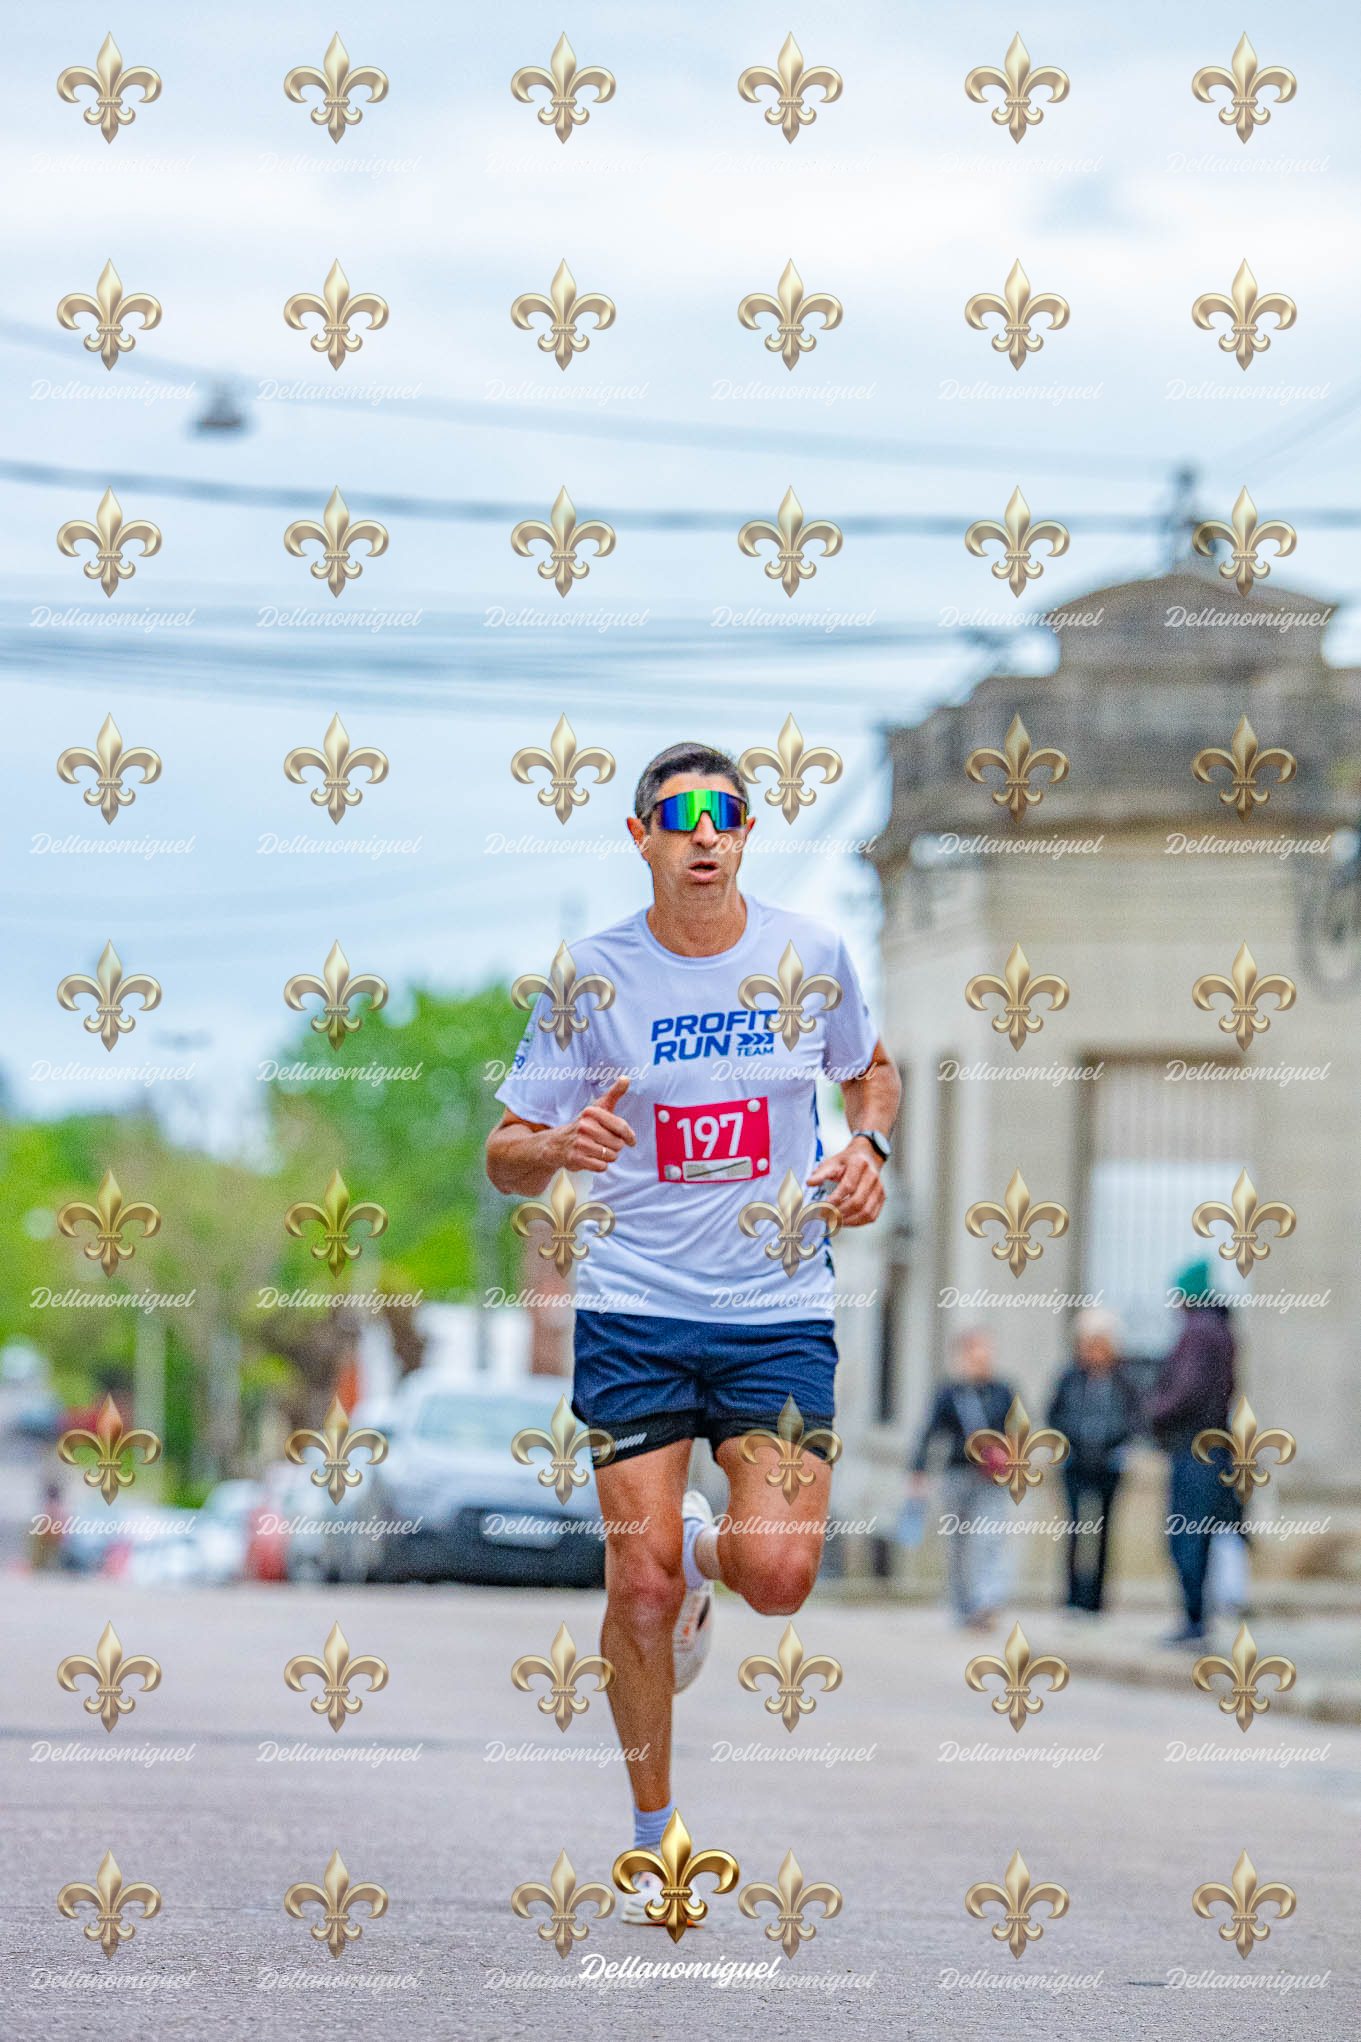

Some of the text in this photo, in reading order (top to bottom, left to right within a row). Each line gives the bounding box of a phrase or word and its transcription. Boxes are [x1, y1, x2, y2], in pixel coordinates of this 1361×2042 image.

[651, 1009, 778, 1042] PROFIT
[653, 1034, 774, 1066] RUN TEAM
[676, 1111, 744, 1159] 197
